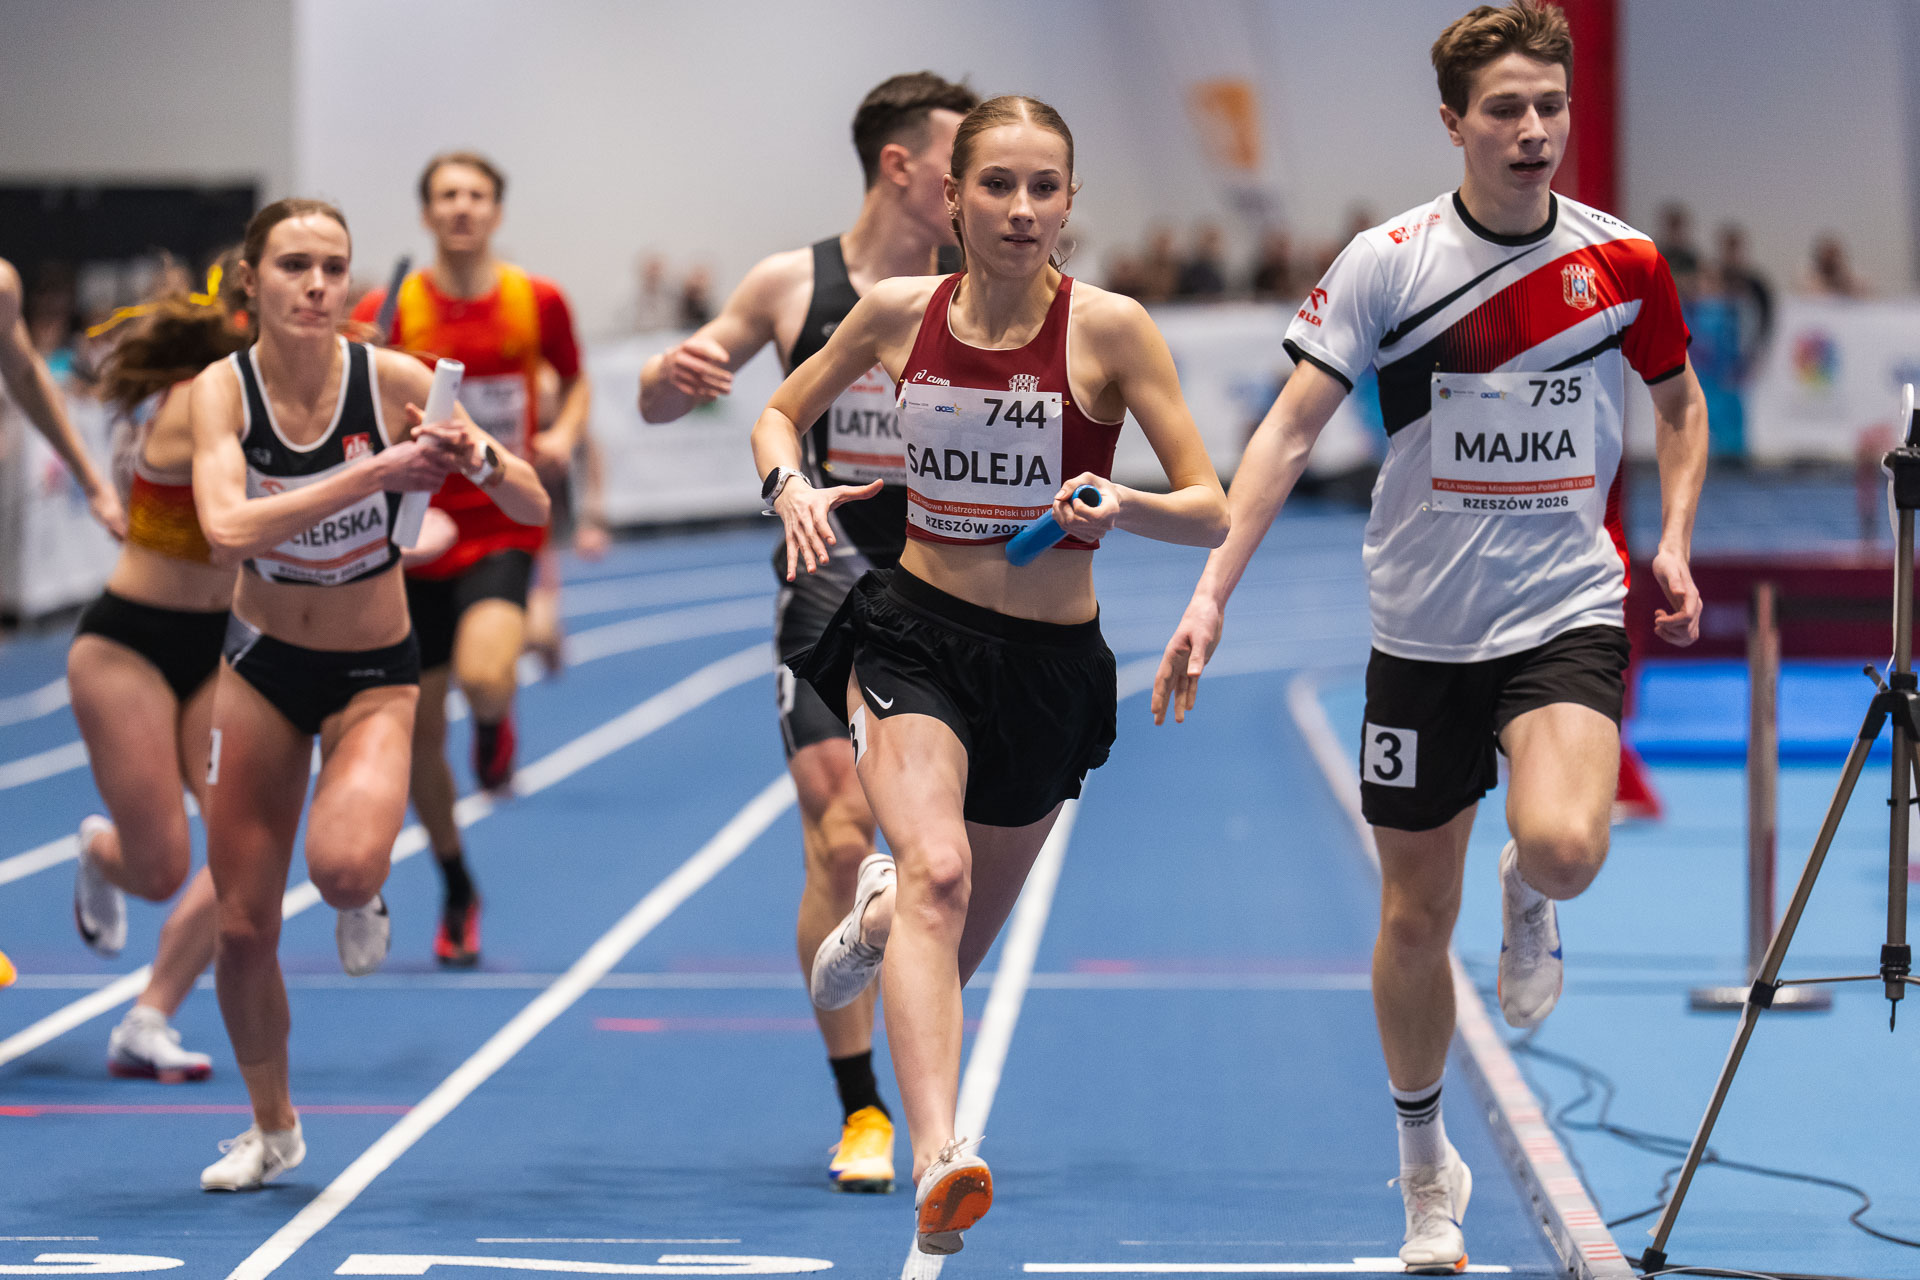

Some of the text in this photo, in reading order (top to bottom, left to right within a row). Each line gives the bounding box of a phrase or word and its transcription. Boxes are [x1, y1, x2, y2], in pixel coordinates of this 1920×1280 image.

[1297, 309, 1322, 327] RLEN
[926, 375, 950, 387] CUNA
[1528, 376, 1582, 407] 735
[984, 398, 1047, 429] 744
[1455, 429, 1577, 463] MAJKA
[907, 443, 1052, 486] SADLEJA
[1488, 484, 1537, 493] Mistrzostwa
[1538, 483, 1559, 492] Polski
[1560, 480, 1573, 489] U18
[1579, 478, 1593, 487] U20
[944, 504, 993, 516] Mistrzostwa
[994, 508, 1019, 518] Polski
[1020, 508, 1035, 518] U18
[1463, 495, 1569, 511] RZESZÓW 2026
[925, 515, 989, 535] RZESZÓW
[1373, 731, 1403, 781] 3
